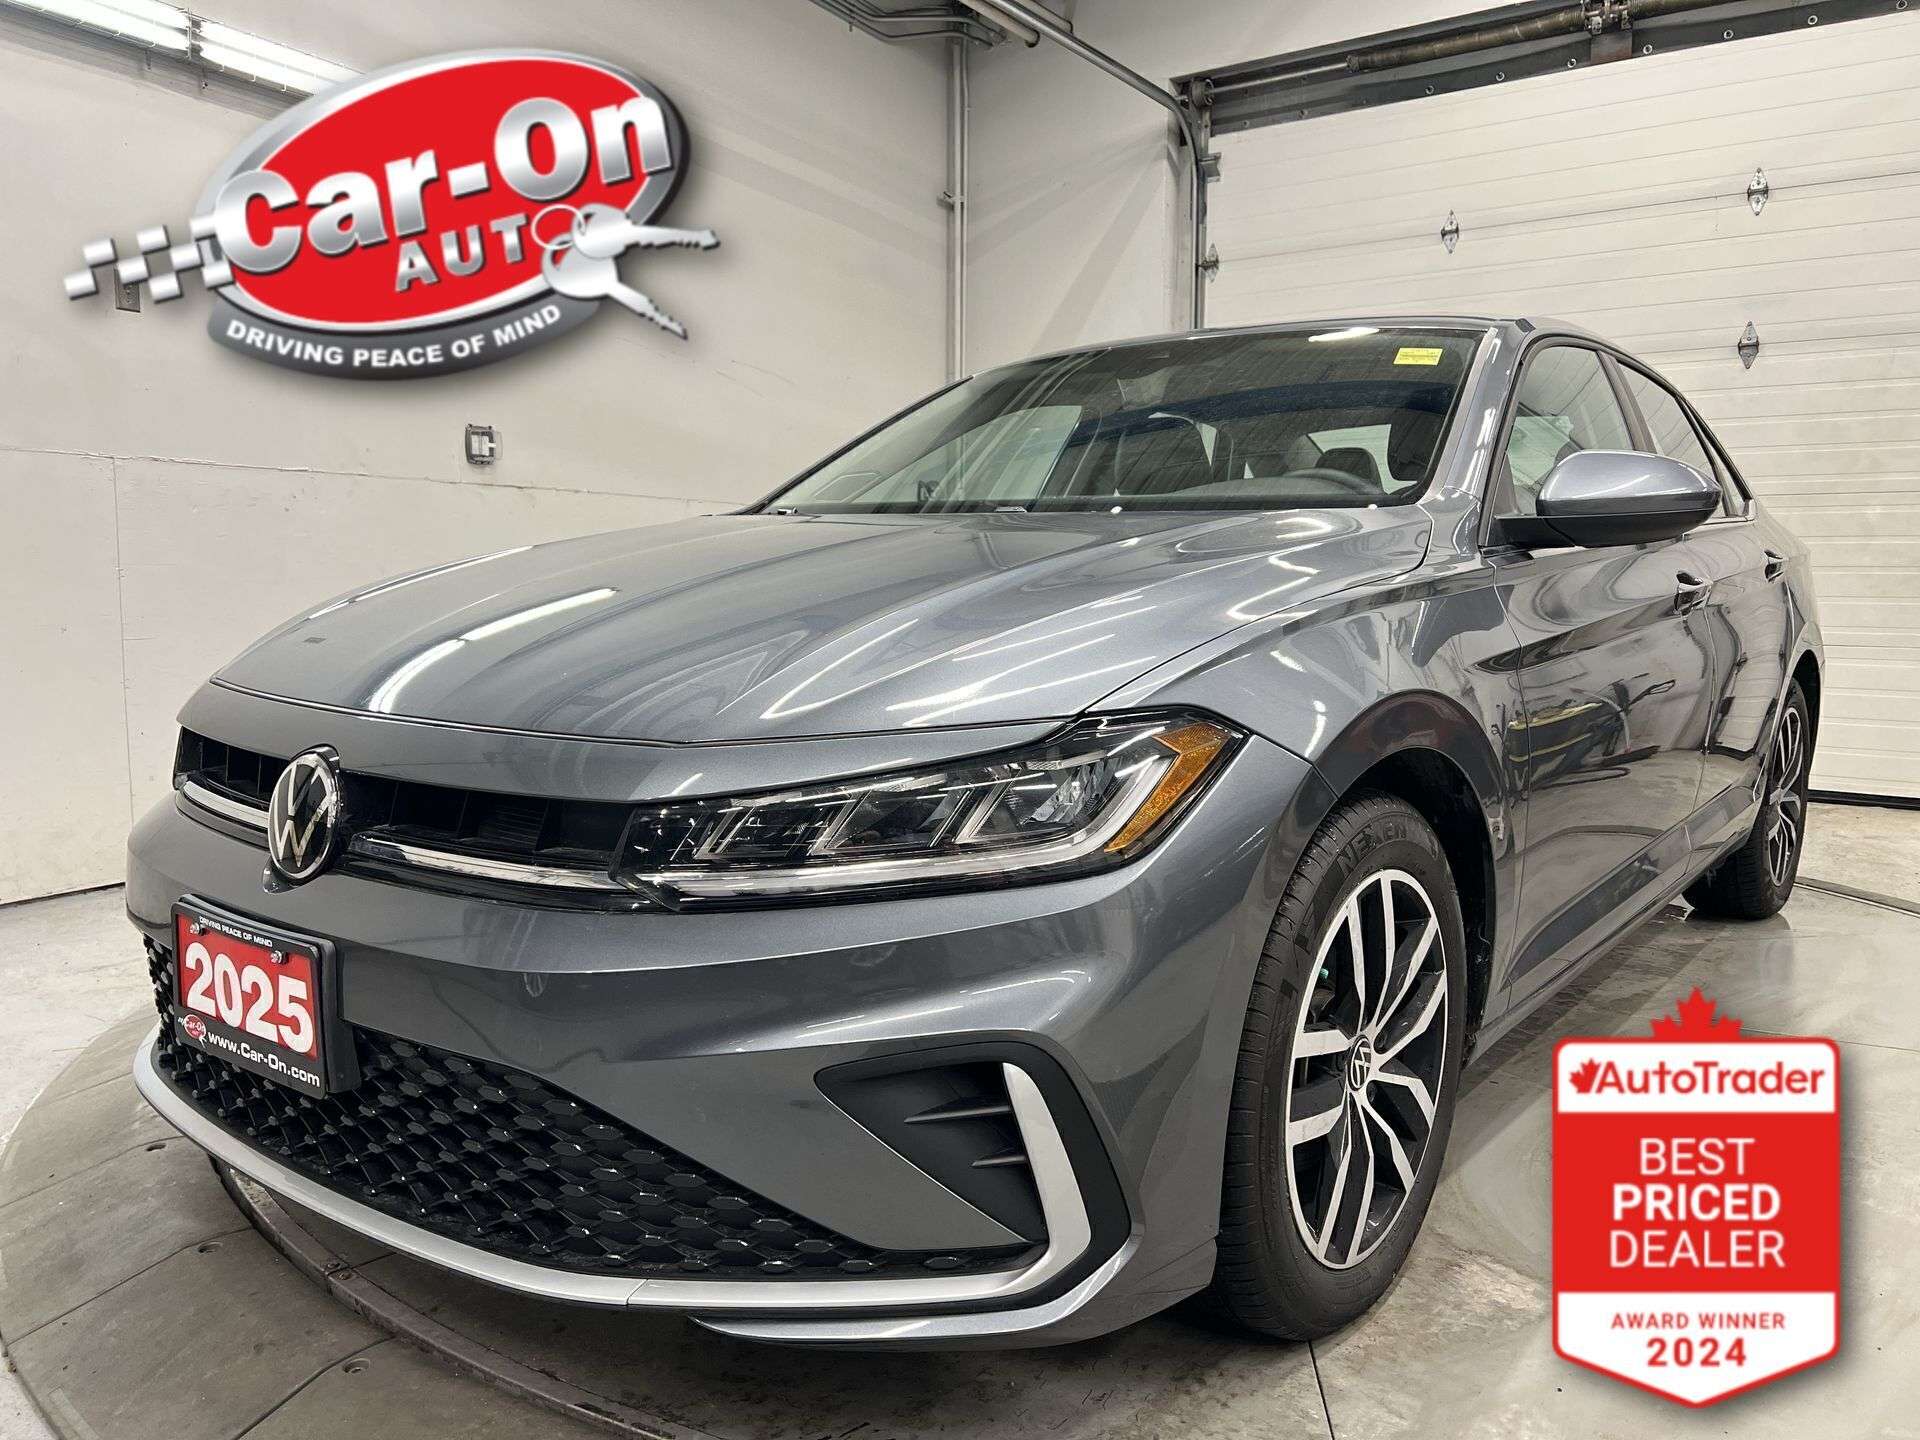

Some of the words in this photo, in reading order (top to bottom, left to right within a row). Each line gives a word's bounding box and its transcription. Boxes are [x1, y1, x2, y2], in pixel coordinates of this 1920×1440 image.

[199, 915, 221, 930] DRIVING
[221, 924, 242, 939] PEACE
[242, 932, 253, 941] OF
[253, 935, 273, 948] MIND
[186, 942, 313, 1052] 2025
[208, 1031, 320, 1087] www.Car-On.com
